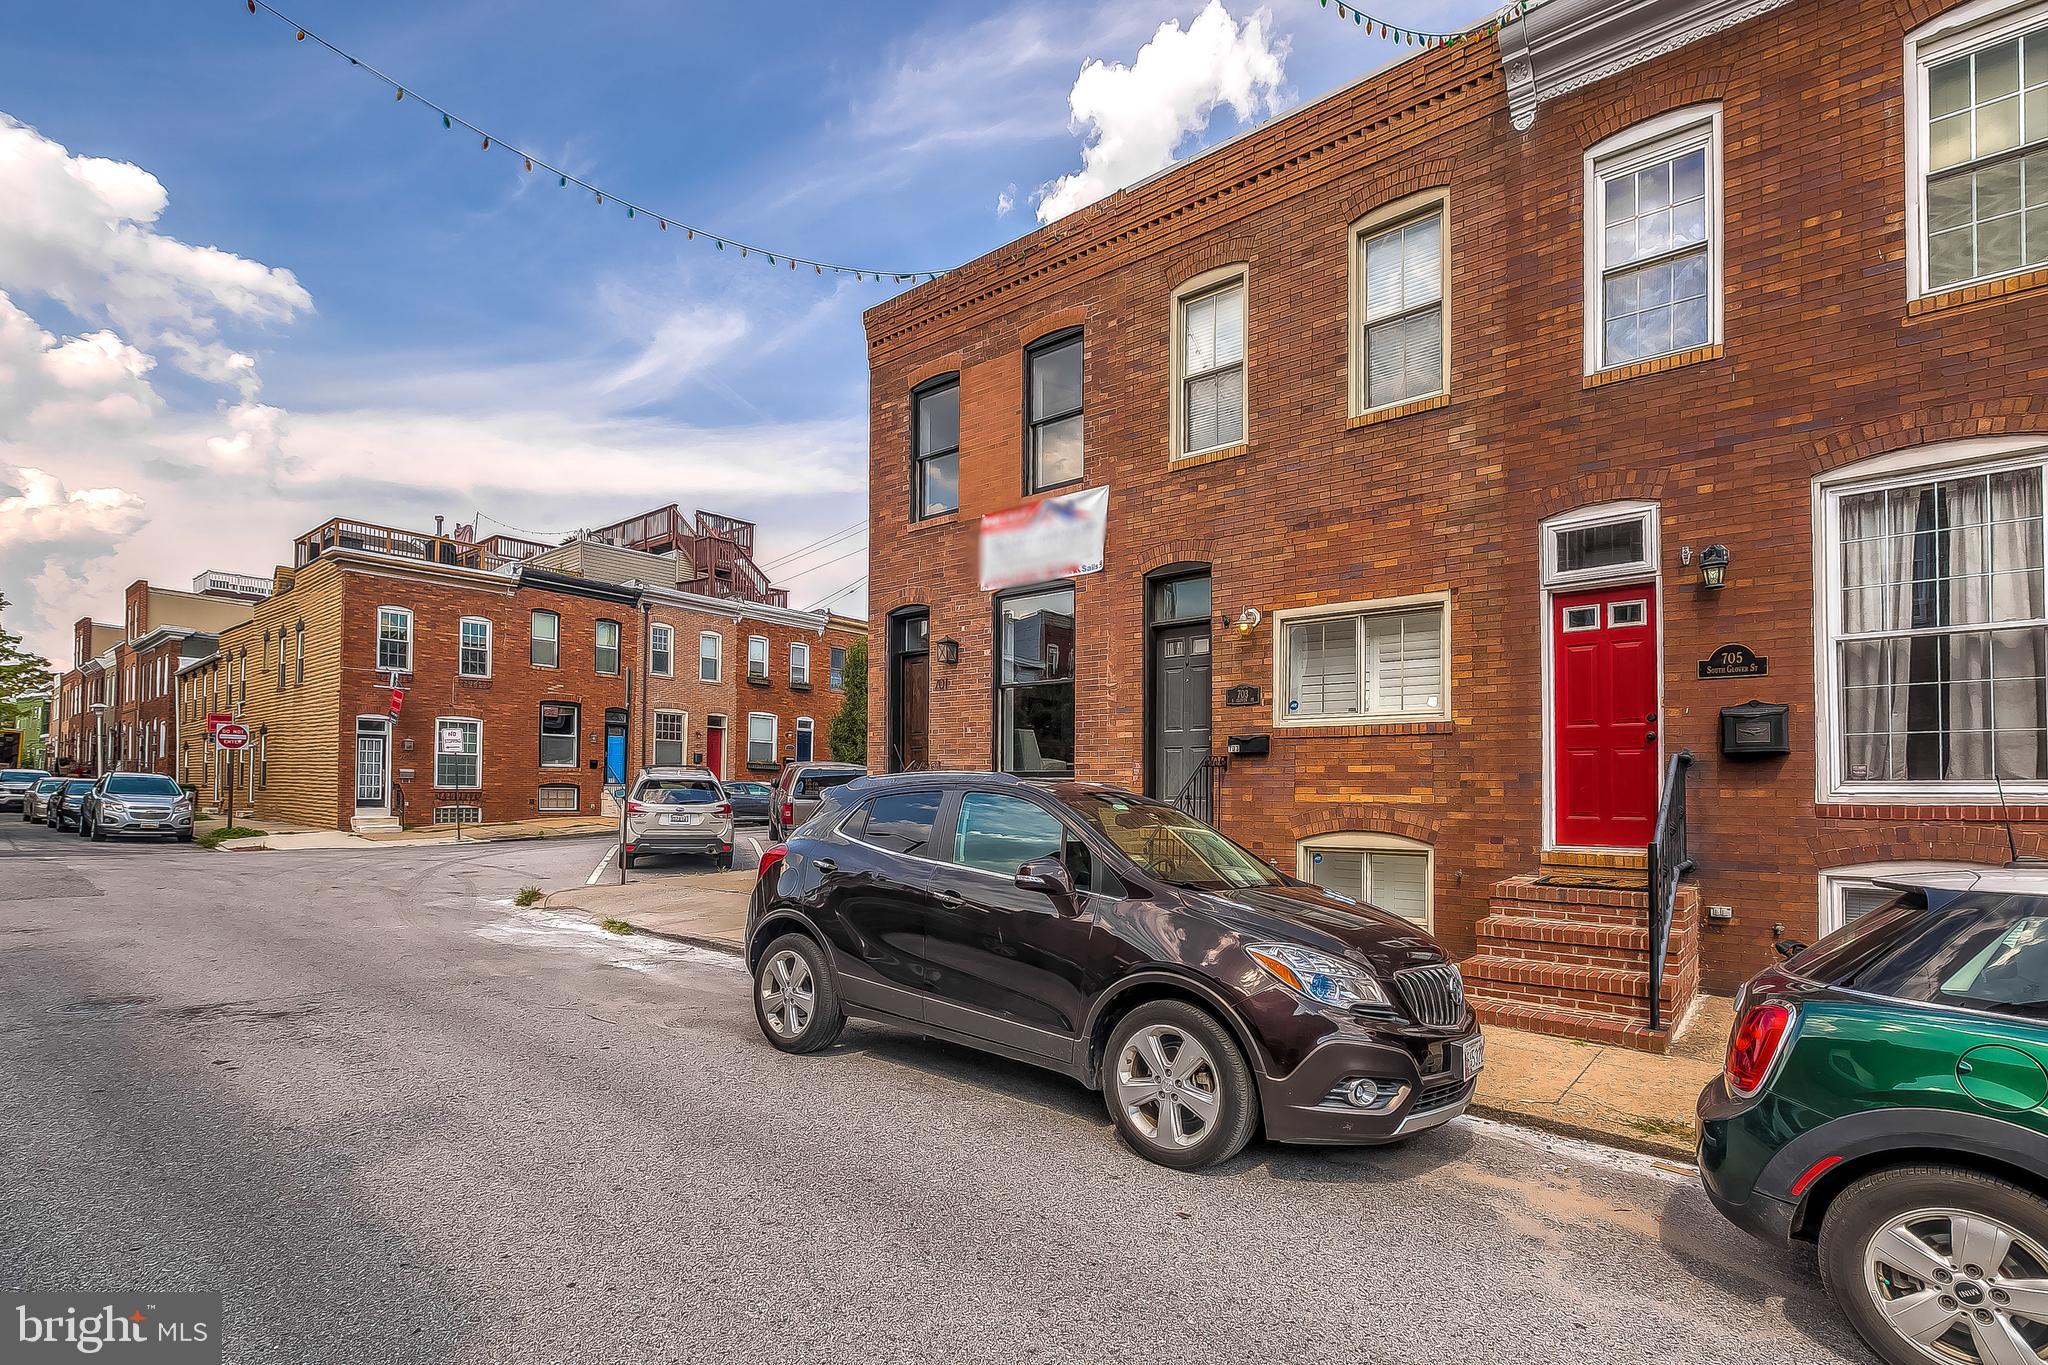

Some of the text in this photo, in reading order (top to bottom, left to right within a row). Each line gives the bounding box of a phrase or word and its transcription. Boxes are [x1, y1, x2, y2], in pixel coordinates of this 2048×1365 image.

[1722, 651, 1743, 664] 705
[934, 678, 948, 690] 701
[1237, 689, 1249, 699] 703
[1958, 1288, 1980, 1298] MINI
